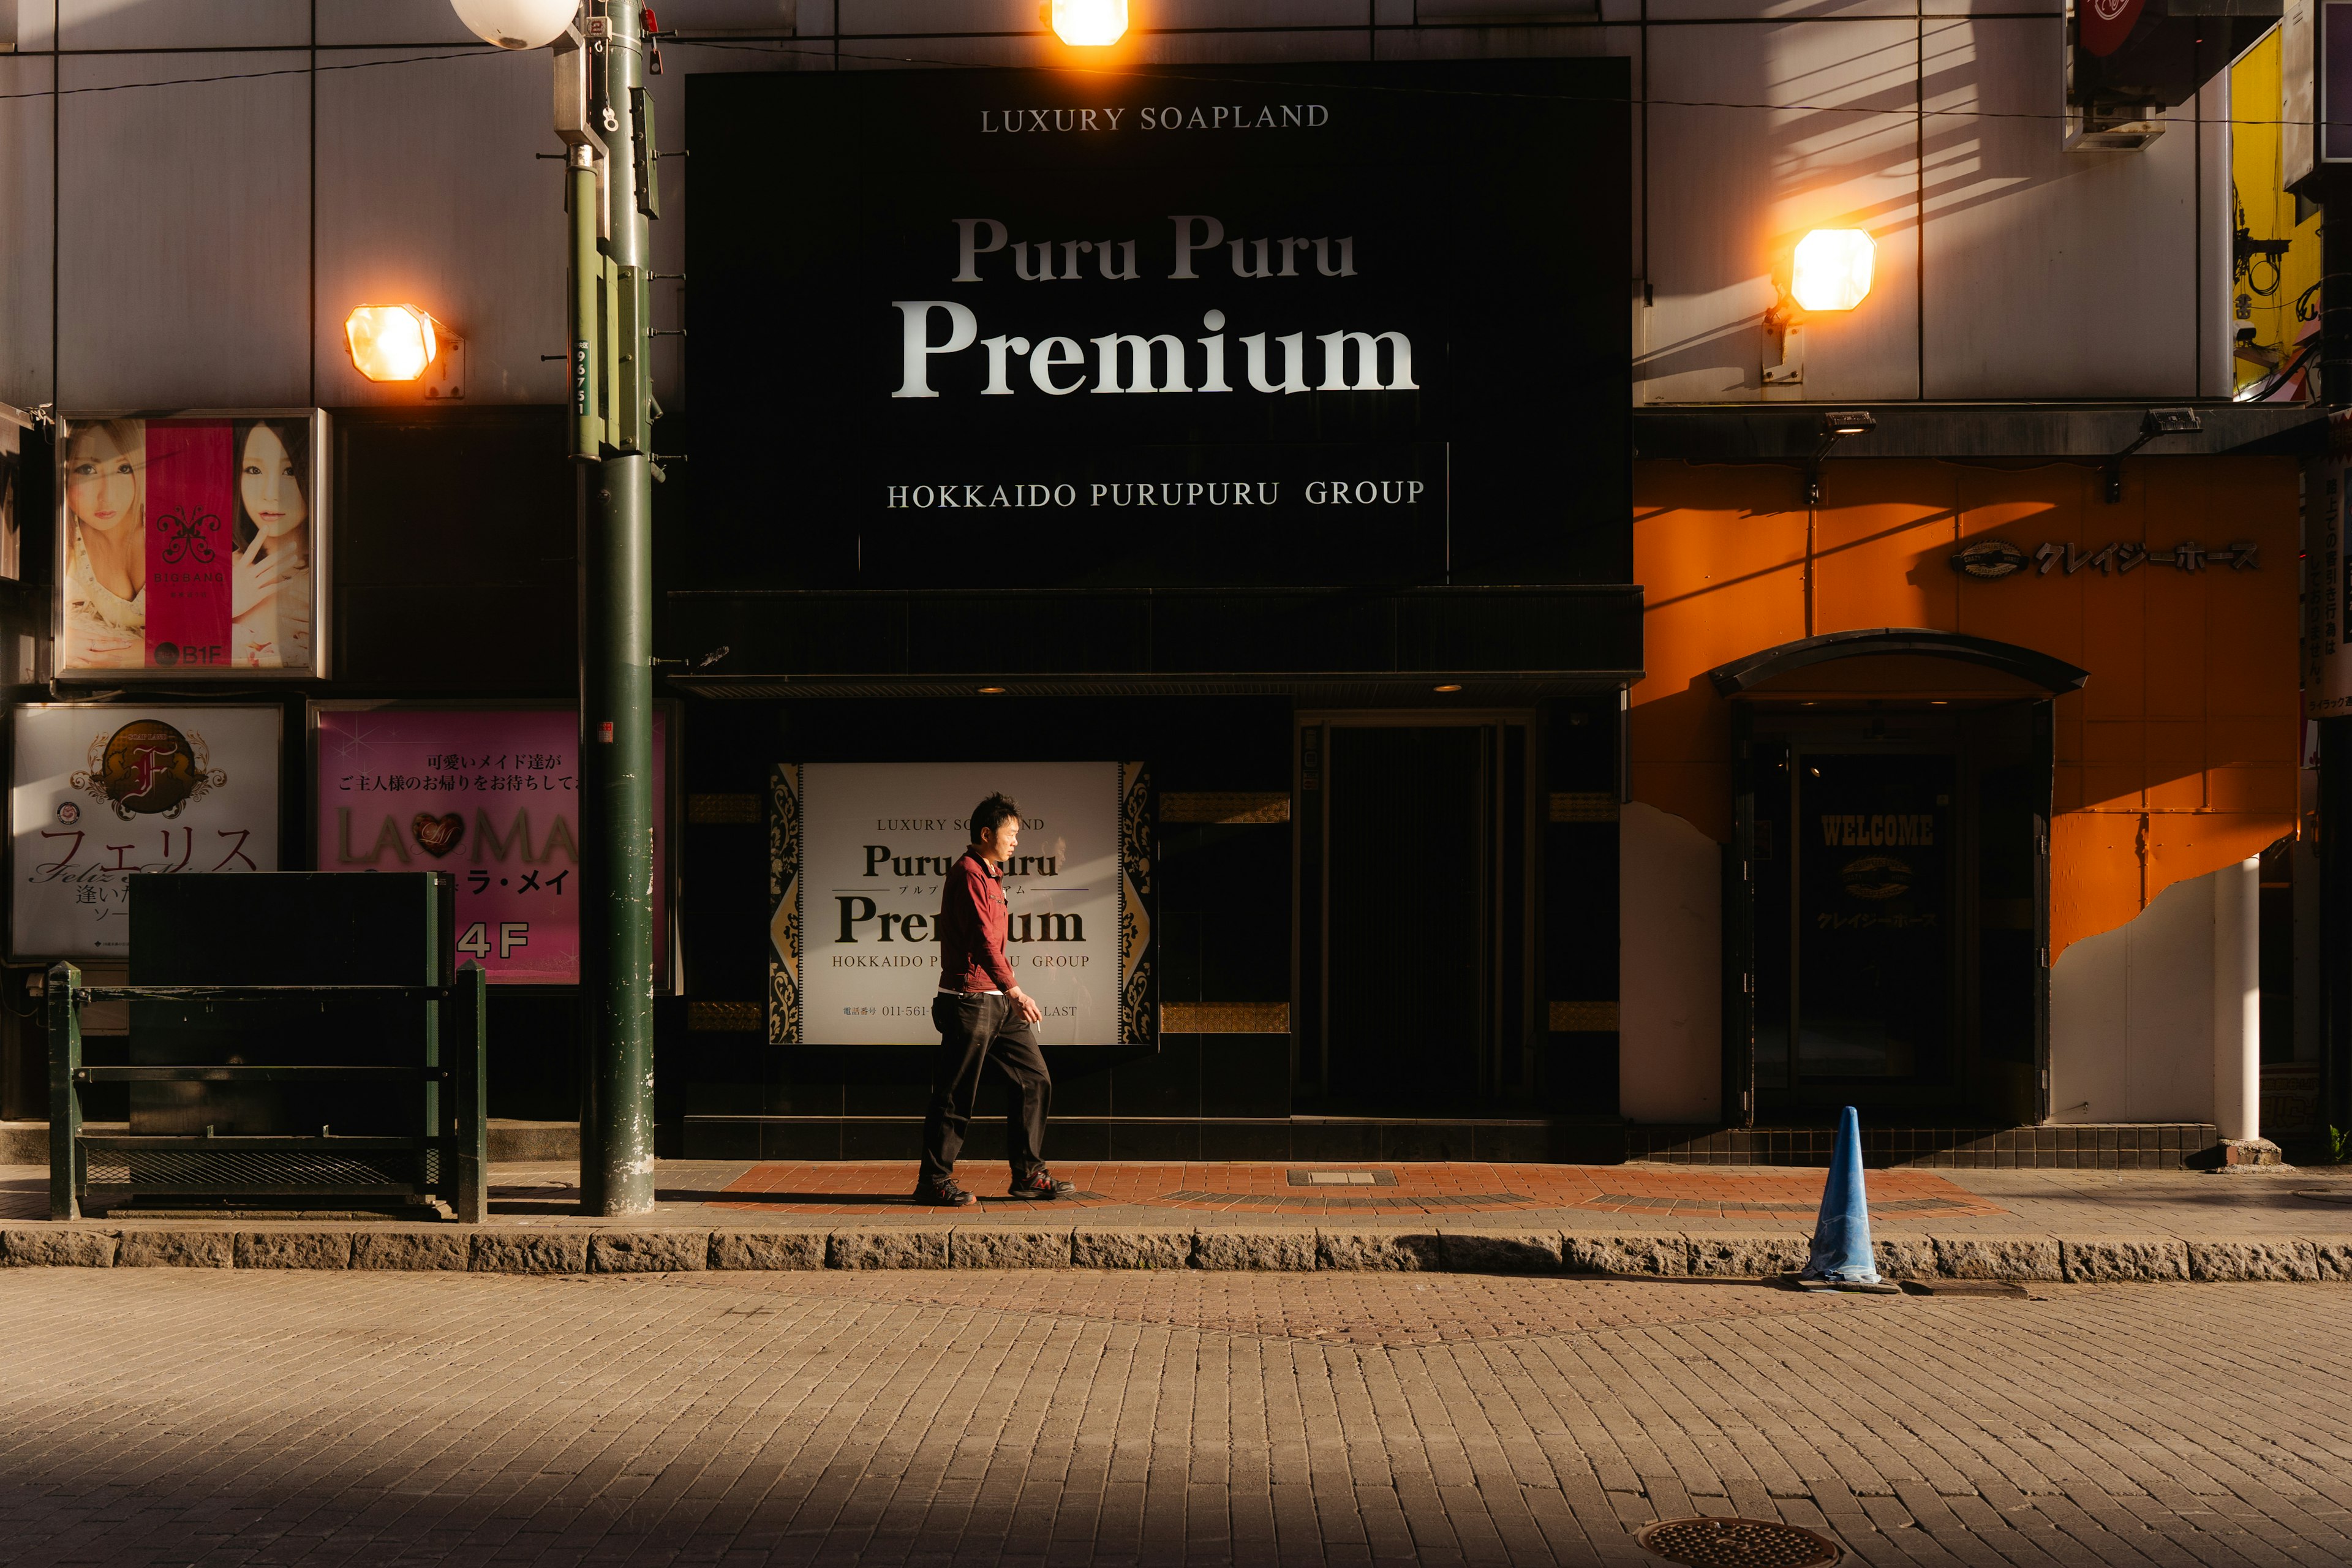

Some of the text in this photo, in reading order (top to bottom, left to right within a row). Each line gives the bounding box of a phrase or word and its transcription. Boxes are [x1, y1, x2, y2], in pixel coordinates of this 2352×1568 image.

[981, 104, 1329, 133] LUXURY SOAPLAND
[951, 215, 1358, 282] Puru Puru
[891, 300, 1420, 398] Premium
[576, 350, 586, 415] 96751
[887, 480, 1425, 508] HOKKAIDO PURUPURU GROUP
[2036, 541, 2259, 575] クレイジーホース
[154, 573, 224, 582] BIGBANG
[183, 645, 222, 664] B1F
[428, 753, 562, 772] 可愛いメイド達が
[877, 819, 1044, 831] LUXURY SOND
[1821, 814, 1934, 846] WELCOME
[40, 826, 257, 873] フェリス
[862, 845, 1058, 877] Puru uru
[834, 895, 1087, 943] Preum
[1817, 911, 1938, 930] クレイジーホース
[456, 921, 529, 959] 4F
[832, 956, 923, 968] HOKKAIDO
[1032, 956, 1090, 968] GROUP
[843, 1006, 876, 1016] 電話番号
